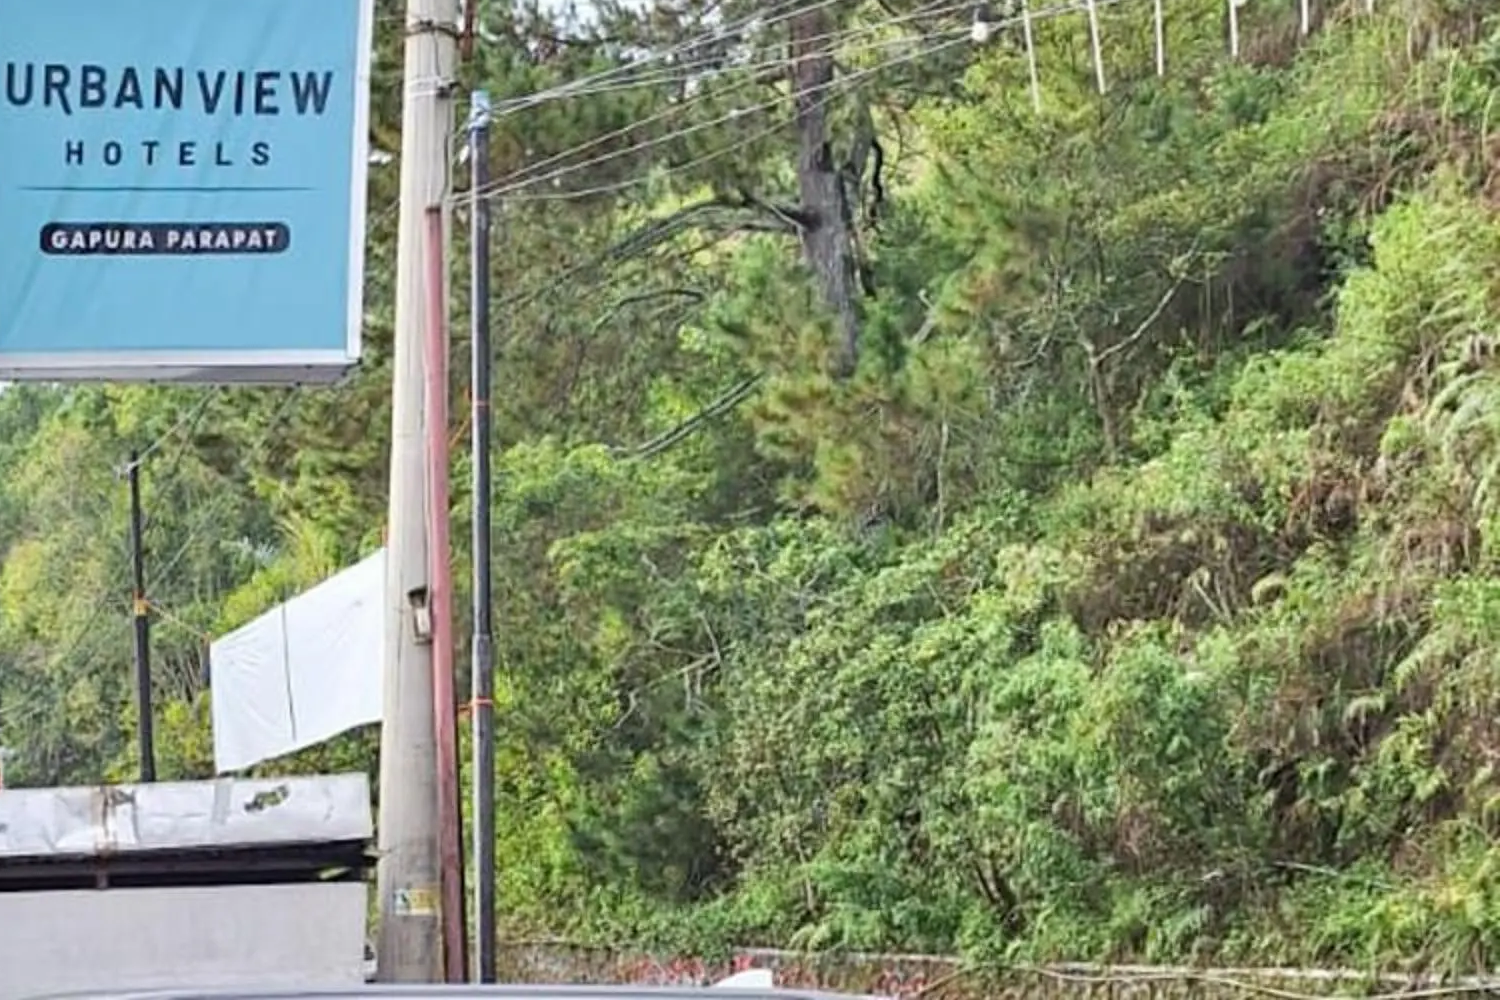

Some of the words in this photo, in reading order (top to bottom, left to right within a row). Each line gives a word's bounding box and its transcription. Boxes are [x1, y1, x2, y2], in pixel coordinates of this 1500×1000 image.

[5, 62, 333, 115] URBANVIEW
[64, 140, 271, 166] HOTELS
[51, 228, 154, 250] GAPURA
[167, 228, 278, 250] PARAPAT
